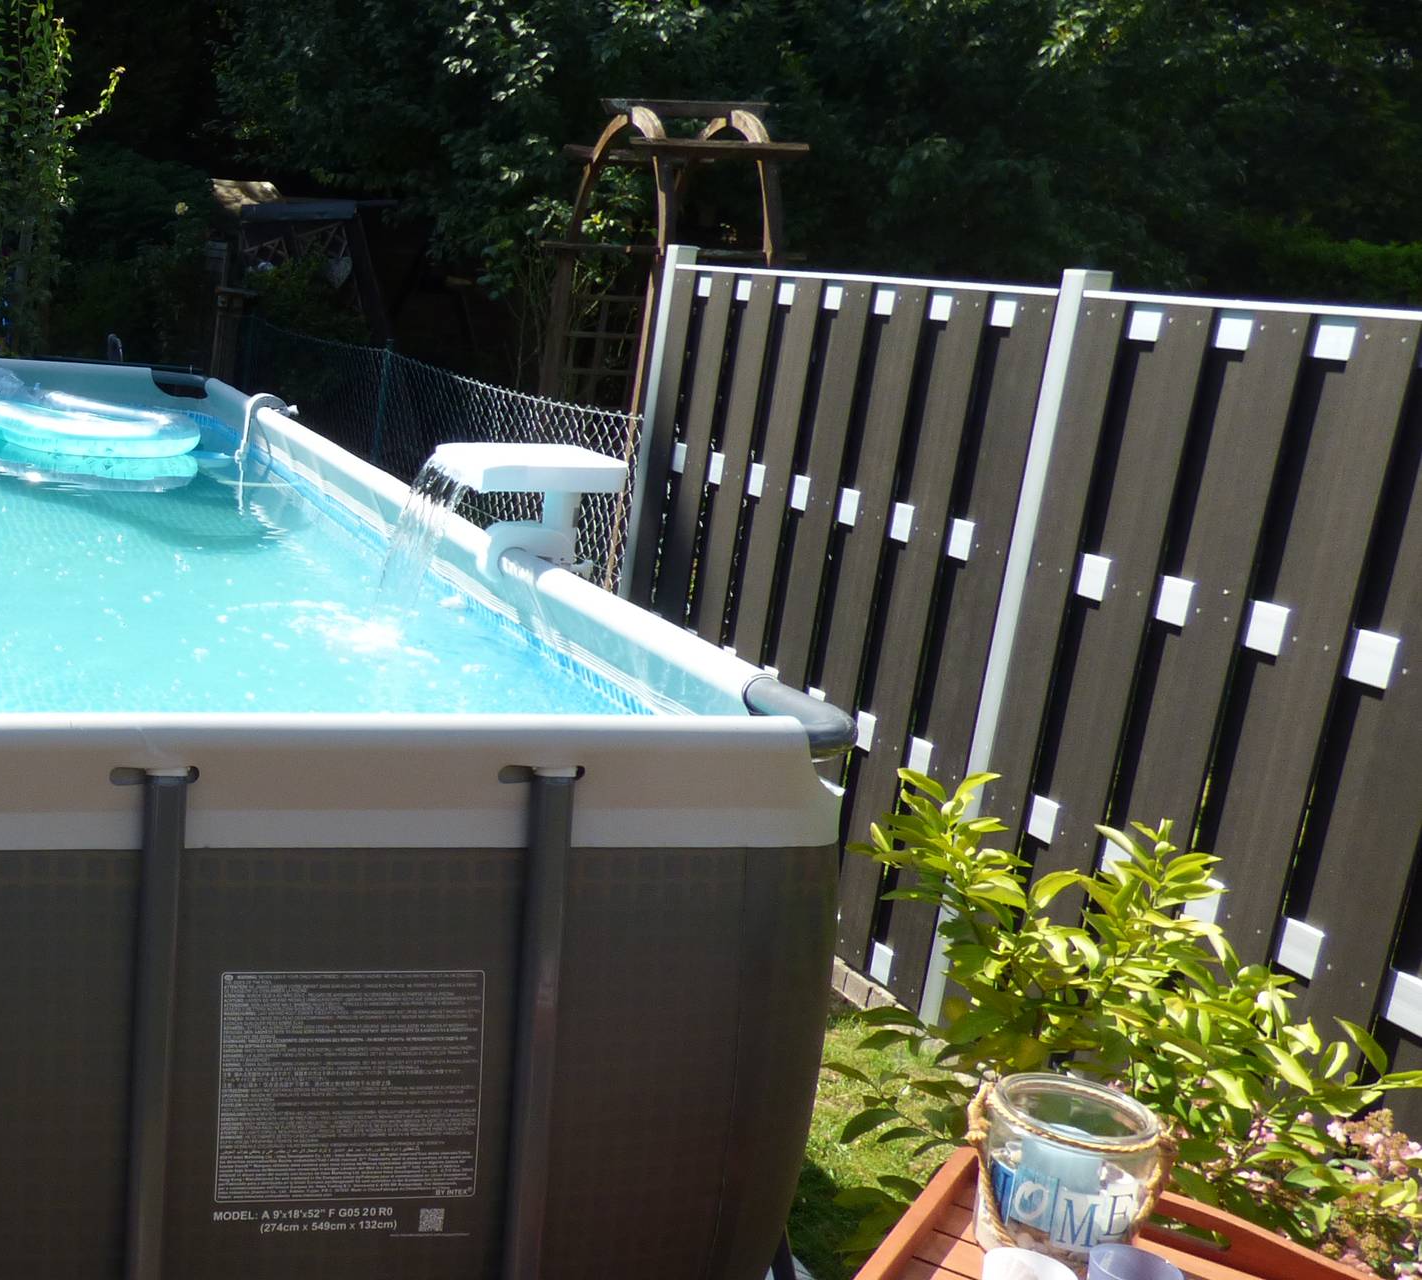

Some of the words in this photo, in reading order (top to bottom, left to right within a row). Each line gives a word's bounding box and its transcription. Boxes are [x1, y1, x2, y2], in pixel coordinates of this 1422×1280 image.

[213, 1210, 259, 1221] MODEL:
[261, 1210, 270, 1220] A
[328, 1208, 336, 1218] F
[338, 1207, 360, 1217] G05
[362, 1207, 377, 1217] 20
[260, 1222, 300, 1235] (274cm
[302, 1223, 309, 1231] x
[311, 1221, 347, 1231] 549cm
[349, 1222, 356, 1230] x
[358, 1219, 398, 1231] 132cm)
